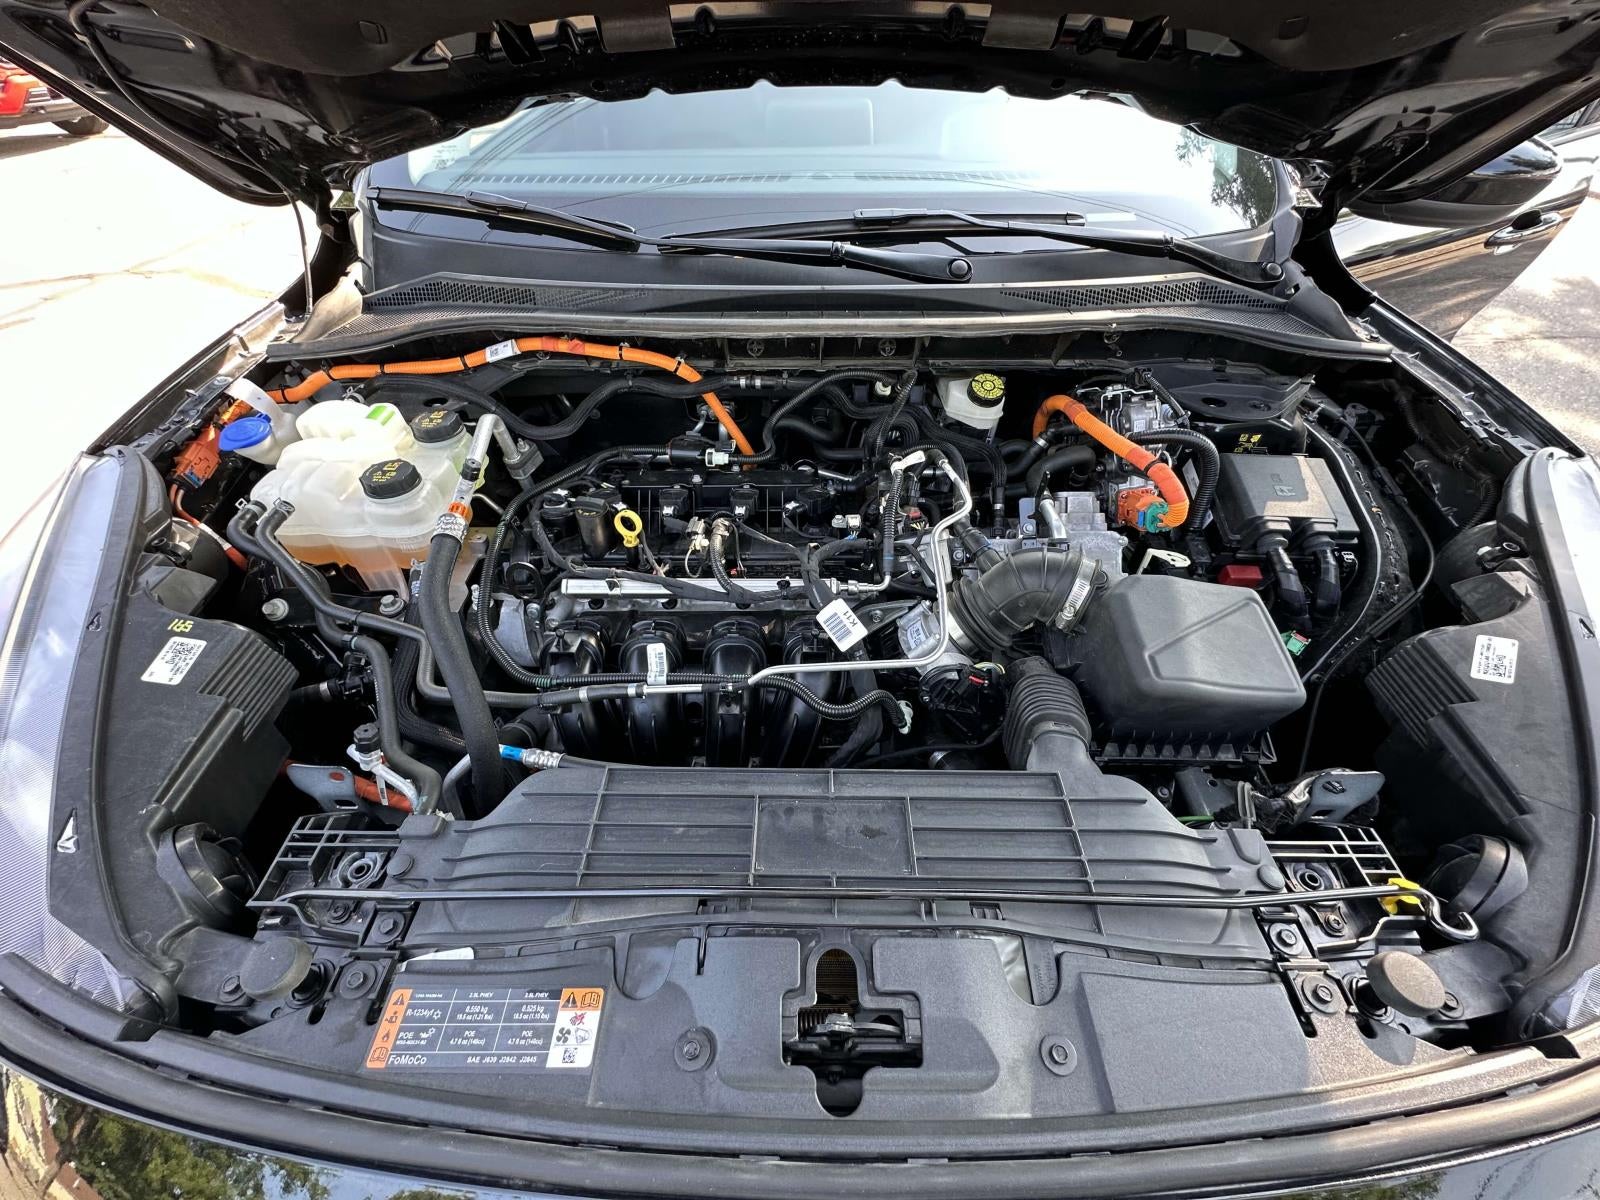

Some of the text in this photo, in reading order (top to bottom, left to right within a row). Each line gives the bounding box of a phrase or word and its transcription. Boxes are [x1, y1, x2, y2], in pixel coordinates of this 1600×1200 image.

[843, 610, 858, 628] K11
[405, 1008, 434, 1018] R-1234yf
[480, 1005, 489, 1014] kg
[537, 1004, 545, 1013] kg
[398, 1031, 415, 1039] POE
[464, 1030, 476, 1038] POE
[521, 1030, 534, 1038] POE
[388, 1054, 428, 1065] FoMoCo
[466, 1055, 481, 1064] SAE
